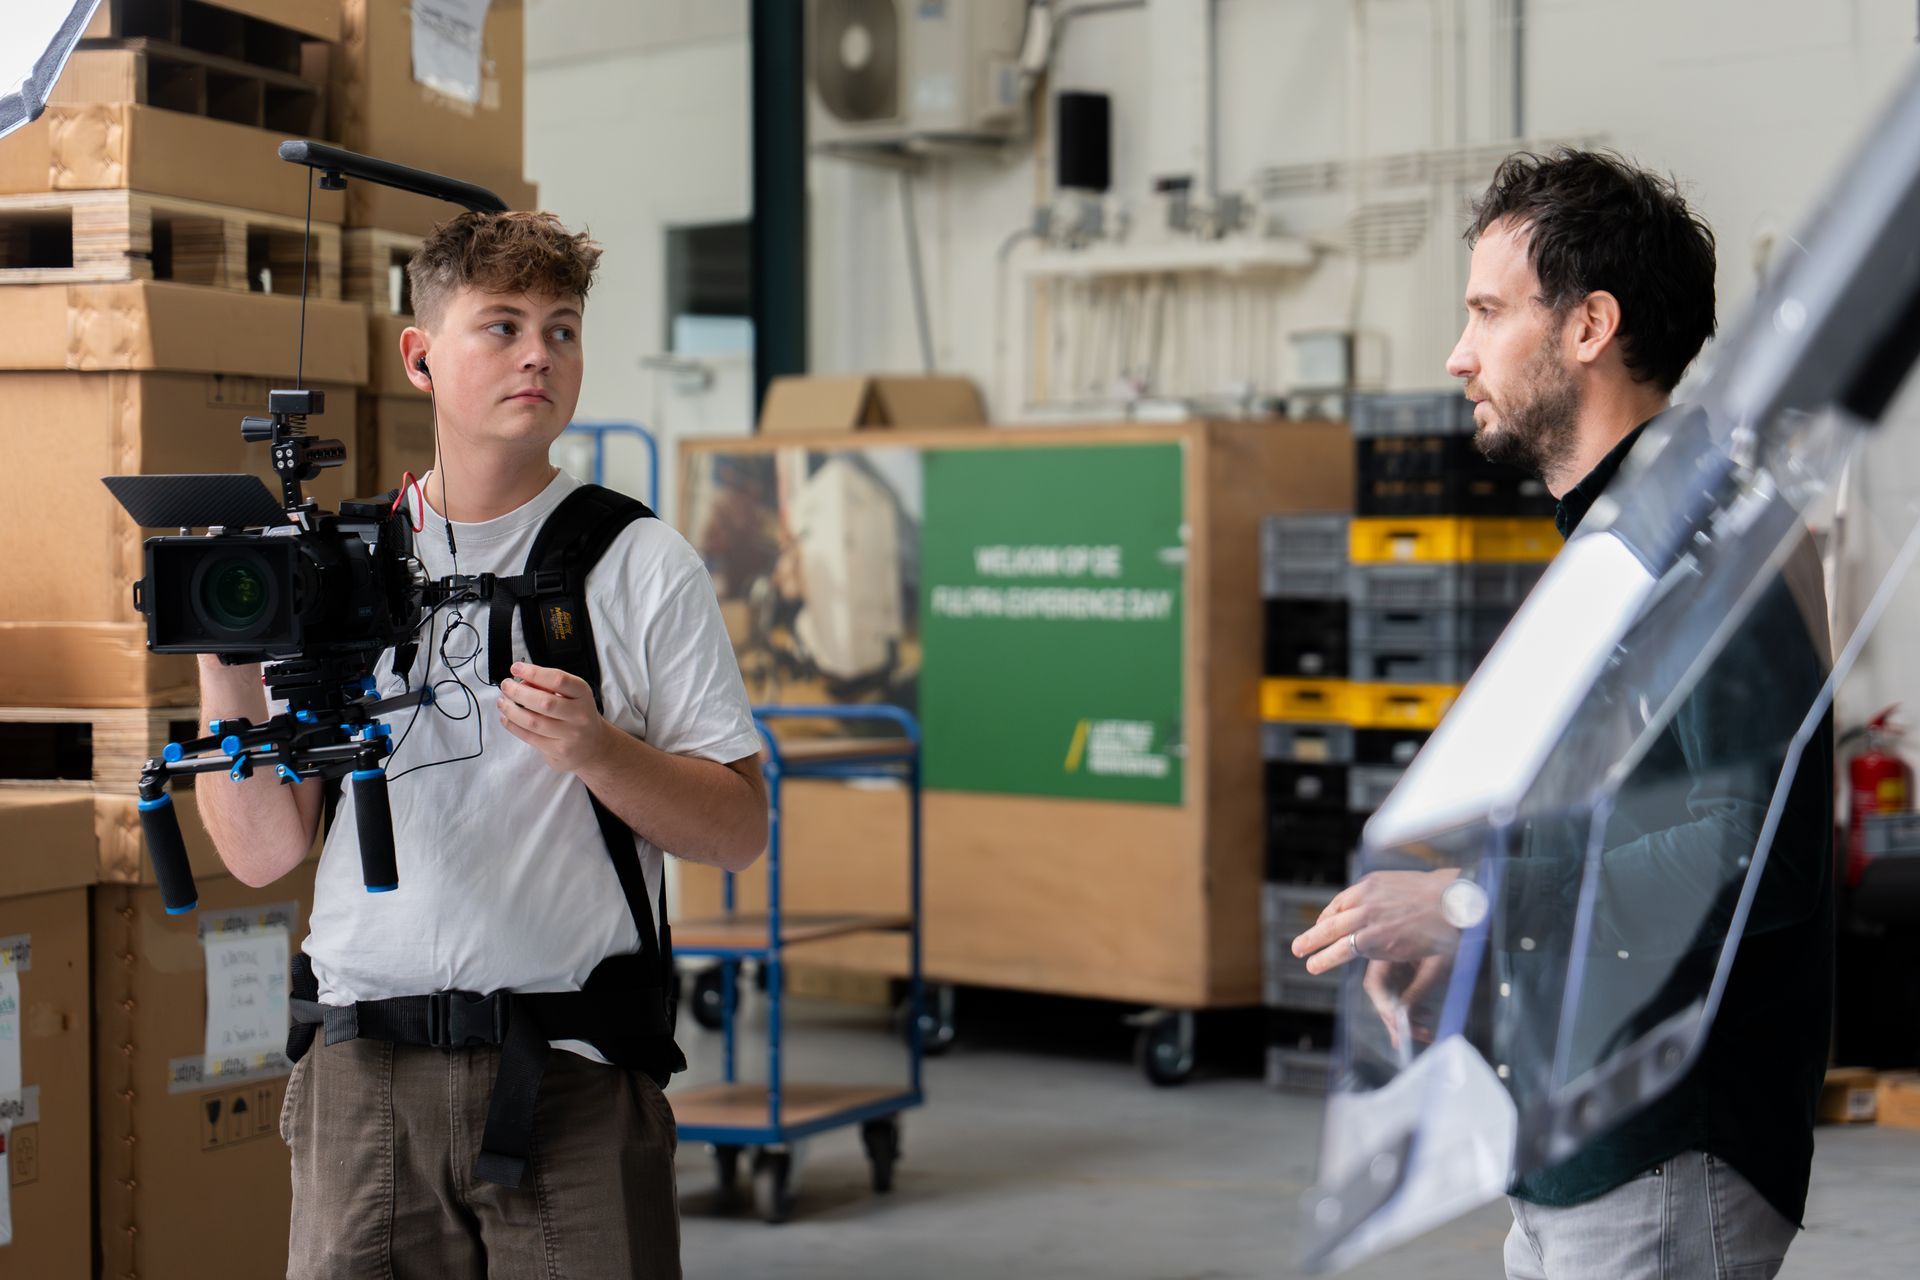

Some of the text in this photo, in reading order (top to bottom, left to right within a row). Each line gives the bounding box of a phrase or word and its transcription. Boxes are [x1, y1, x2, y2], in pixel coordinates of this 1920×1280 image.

[974, 546, 1122, 577] WELKOM OP DE
[1005, 587, 1123, 619] EXPERIENCE
[1127, 589, 1172, 620] DAY
